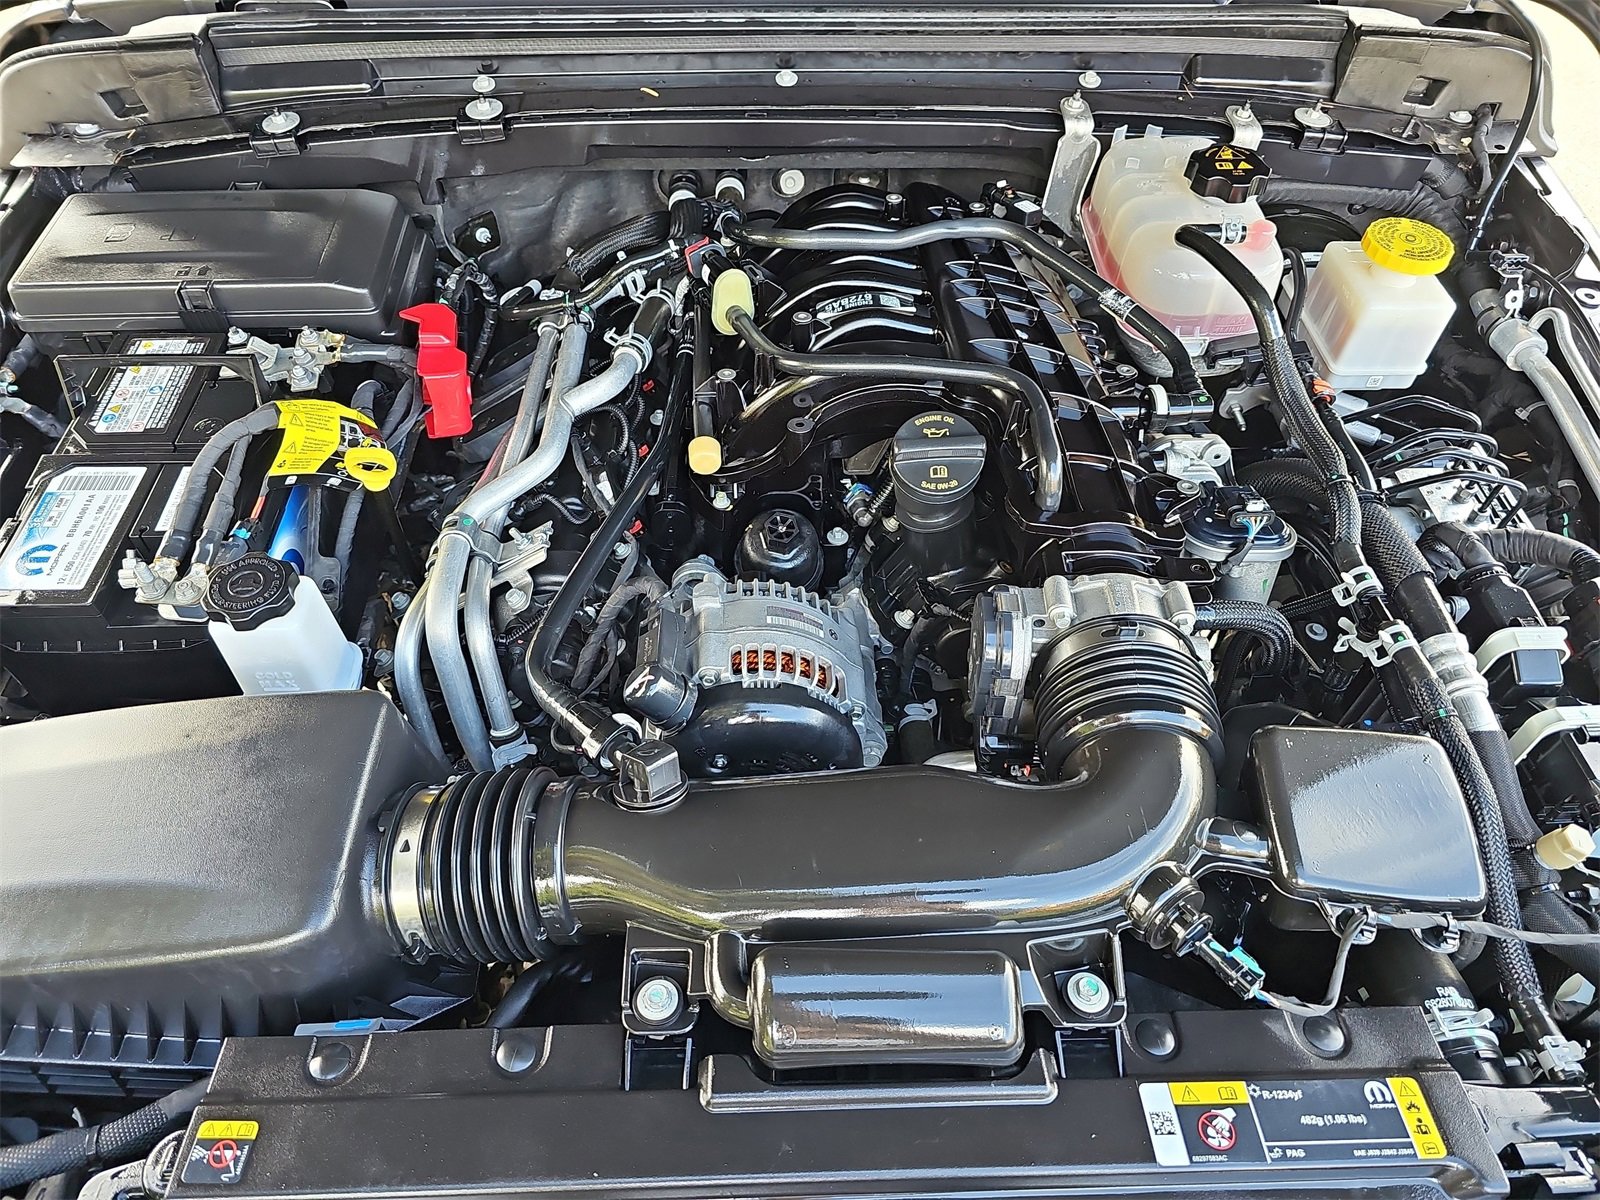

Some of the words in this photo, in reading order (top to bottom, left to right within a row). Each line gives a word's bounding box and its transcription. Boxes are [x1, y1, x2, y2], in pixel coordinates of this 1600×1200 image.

[844, 301, 874, 310] ENGINE
[914, 414, 942, 426] ENGINE
[943, 416, 955, 424] OIL
[920, 480, 936, 490] SAE
[937, 479, 958, 490] 0W-20
[46, 544, 69, 576] MOPAR
[238, 557, 279, 572] APPROVED
[223, 596, 265, 610] STEERING
[1261, 1089, 1303, 1101] R-1234yf
[1347, 1113, 1368, 1126] lbs)
[1285, 1148, 1306, 1158] PAG
